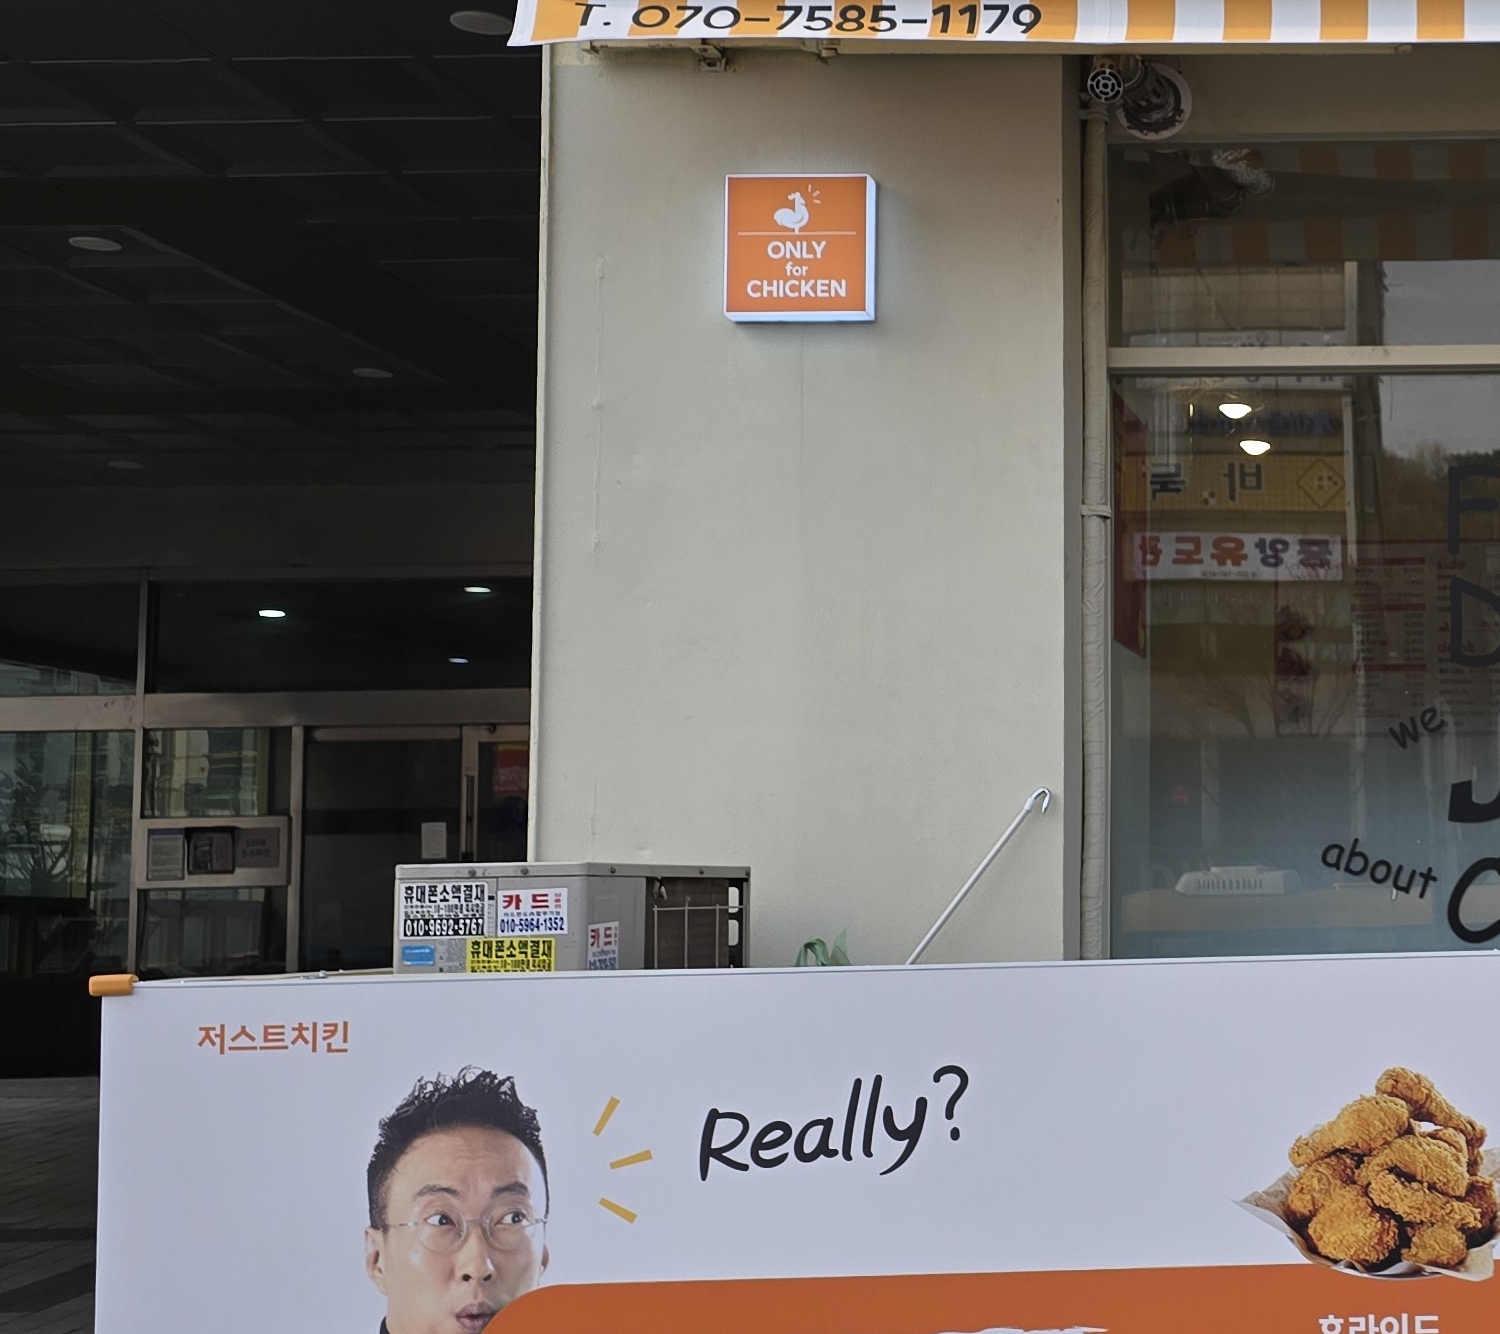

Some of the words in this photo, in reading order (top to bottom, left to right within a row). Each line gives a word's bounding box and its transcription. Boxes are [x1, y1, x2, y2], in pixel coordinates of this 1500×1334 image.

[574, 2, 612, 28] T.
[631, 2, 1042, 35] 070-7585-1179
[767, 240, 826, 260] ONLY
[785, 261, 808, 277] for
[746, 279, 847, 299] CHICKEN
[1387, 701, 1446, 751] we
[1321, 837, 1439, 900] about
[198, 1021, 350, 1055] 저스트치킨
[698, 1064, 969, 1181] Really?
